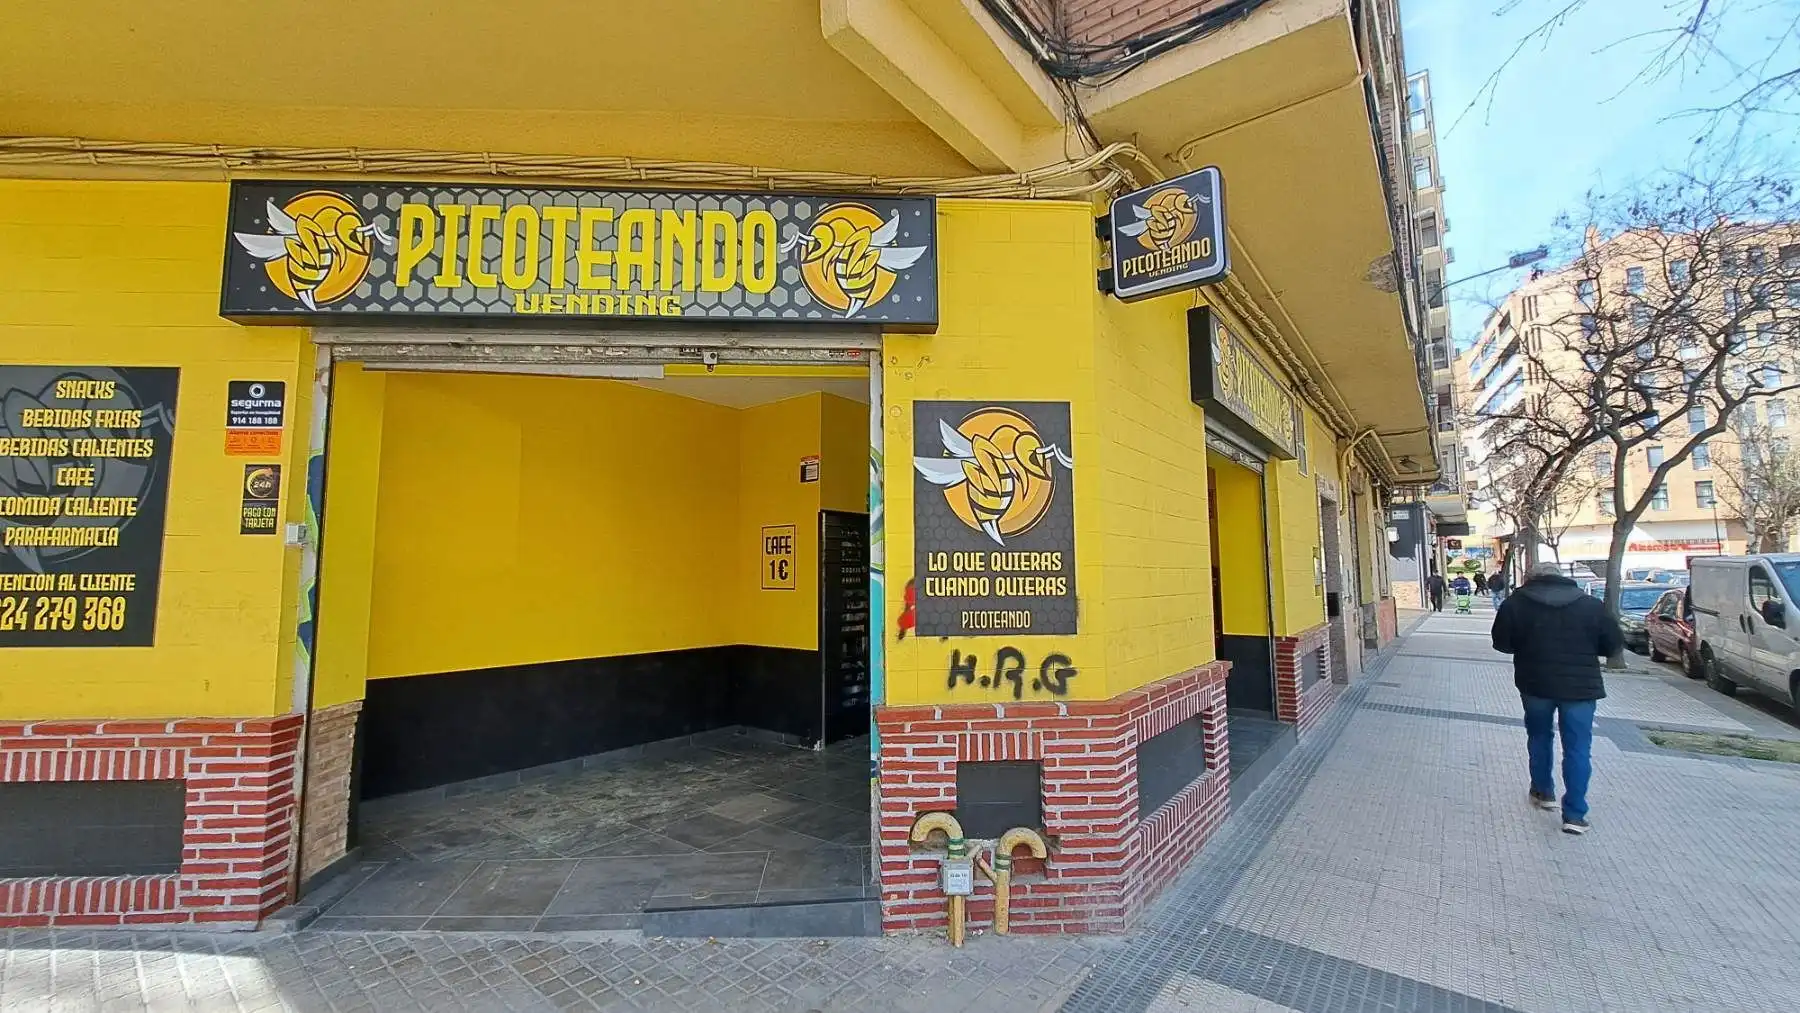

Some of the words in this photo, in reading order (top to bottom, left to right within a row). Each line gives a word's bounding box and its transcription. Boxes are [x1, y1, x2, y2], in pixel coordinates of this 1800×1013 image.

[396, 203, 777, 294] PICOTEANDO
[1122, 237, 1211, 278] PICOTEANDO
[1149, 262, 1189, 277] VENDING
[515, 293, 681, 316] VENDING
[56, 380, 116, 400] SNACKS
[231, 399, 282, 409] segurma
[23, 408, 92, 428] BEBIDAS
[95, 409, 142, 429] FRIAS
[232, 417, 246, 425] 914
[248, 417, 262, 425] 188
[0, 438, 69, 458] BEBIDAS
[72, 439, 154, 459] CALIENTES
[56, 464, 96, 487] CAFÉ
[0, 497, 61, 516] COMIDA
[65, 497, 138, 517] CALIENTE
[243, 507, 261, 517] PAGO
[263, 507, 276, 517] CON
[245, 518, 274, 528] TARJETA
[5, 527, 120, 547] PARAFARMACIA
[769, 559, 789, 580] 1€
[928, 552, 948, 572] LO
[953, 552, 985, 573] QUE
[990, 552, 1062, 573] QUIERAS
[0, 573, 55, 592] TENCION
[58, 574, 77, 592] AL
[80, 574, 136, 592] CLIENTE
[925, 577, 990, 597] CUANDO
[995, 577, 1067, 597] QUIERAS
[0, 596, 30, 631] 24
[34, 596, 77, 631] 279
[82, 596, 127, 631] 368
[961, 611, 1031, 629] PICOTEANDO
